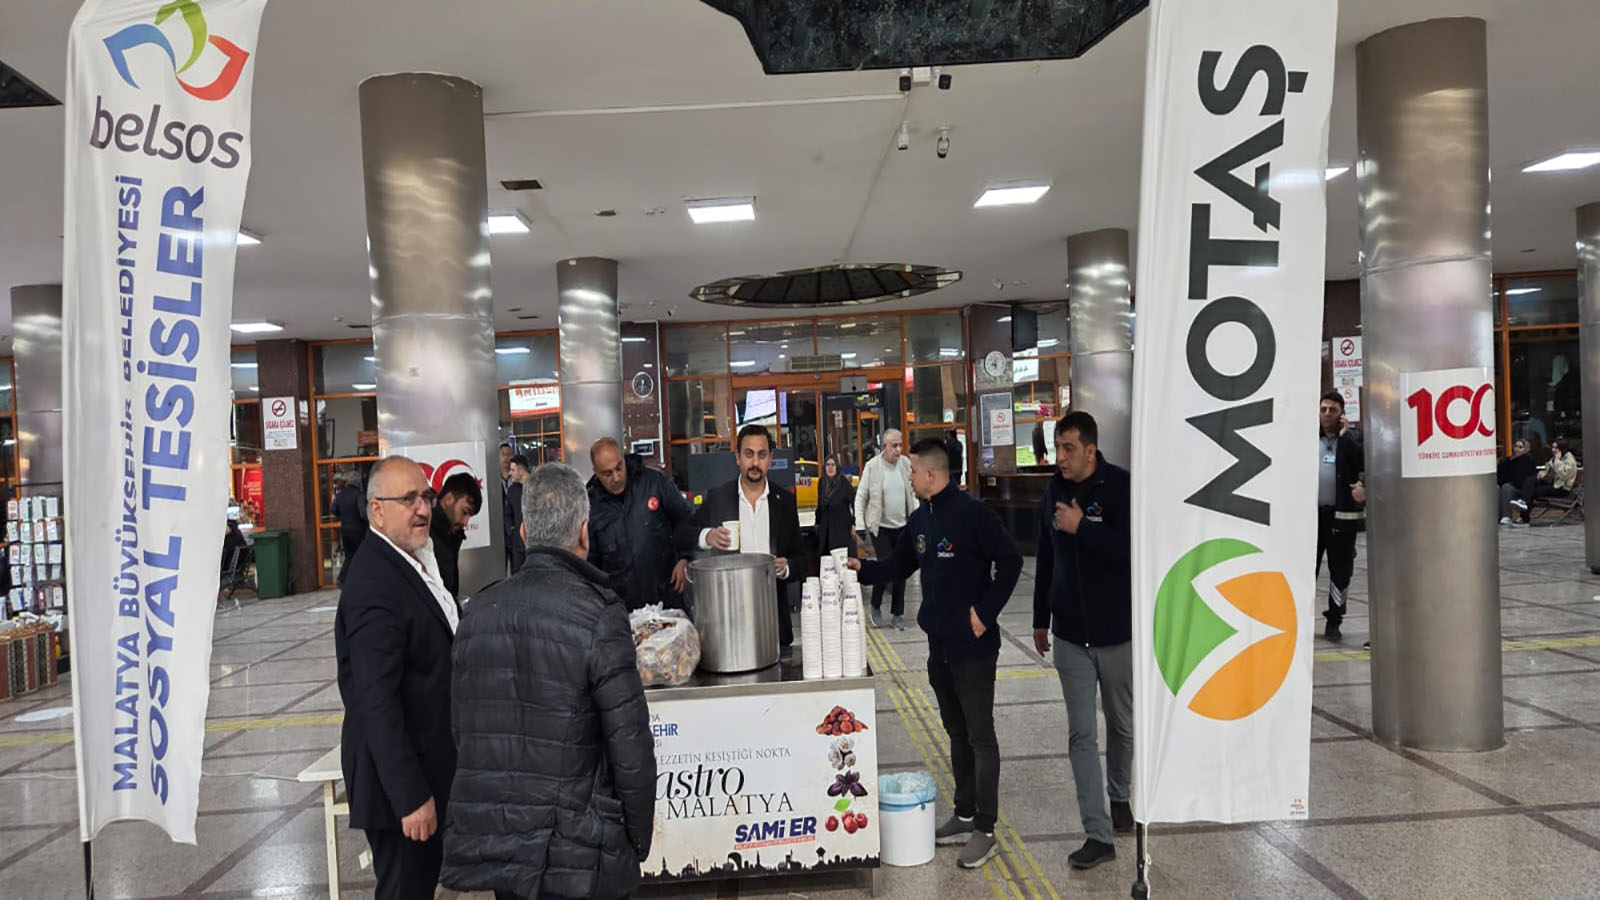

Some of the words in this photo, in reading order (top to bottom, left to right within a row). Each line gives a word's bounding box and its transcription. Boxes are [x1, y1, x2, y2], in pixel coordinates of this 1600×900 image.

[90, 94, 244, 169] belsos
[115, 174, 143, 382] BELEDİYESİ
[1183, 44, 1309, 527] MOTAŞ
[136, 186, 204, 511] TESİSLER
[112, 631, 140, 792] MALATYA
[142, 535, 182, 807] SOSYAL
[656, 764, 745, 801] astro
[659, 752, 702, 766] EZZETİN
[756, 747, 791, 759] NOKTA
[667, 791, 794, 820] MALATYA
[789, 816, 817, 837] ER
